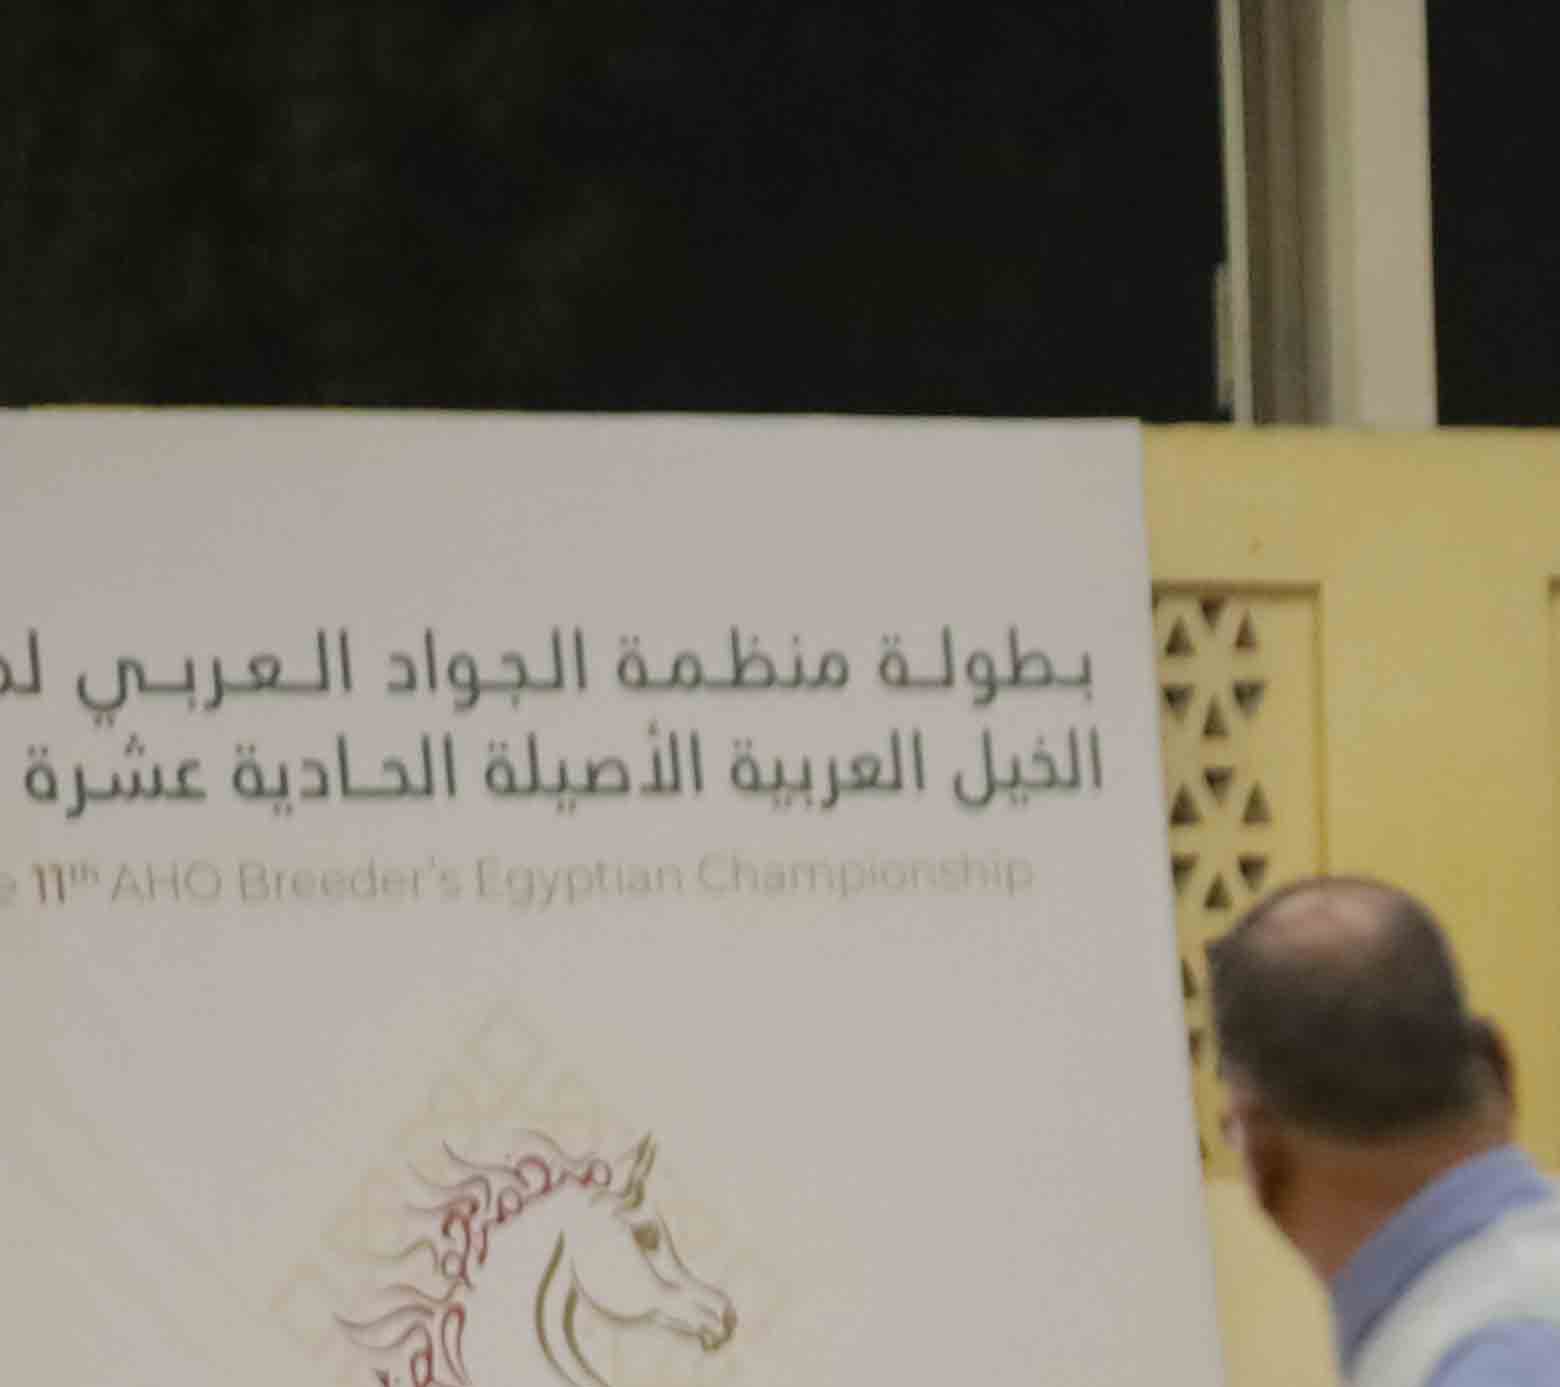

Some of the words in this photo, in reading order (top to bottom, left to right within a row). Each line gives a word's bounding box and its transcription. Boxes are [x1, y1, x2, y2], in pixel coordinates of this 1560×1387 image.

[386, 625, 588, 714] الجواد
[616, 624, 850, 692] منظمة
[879, 623, 1093, 706] بطولة
[23, 732, 207, 821] عشرة
[231, 730, 457, 818] الحادية
[484, 720, 704, 816] الأصيلة
[728, 727, 927, 812] العربية
[953, 725, 1104, 808] الخيل
[110, 858, 224, 903] AHO
[238, 856, 461, 902] Breeder's
[476, 853, 685, 908] Egyptian
[697, 849, 1038, 901] Championship
